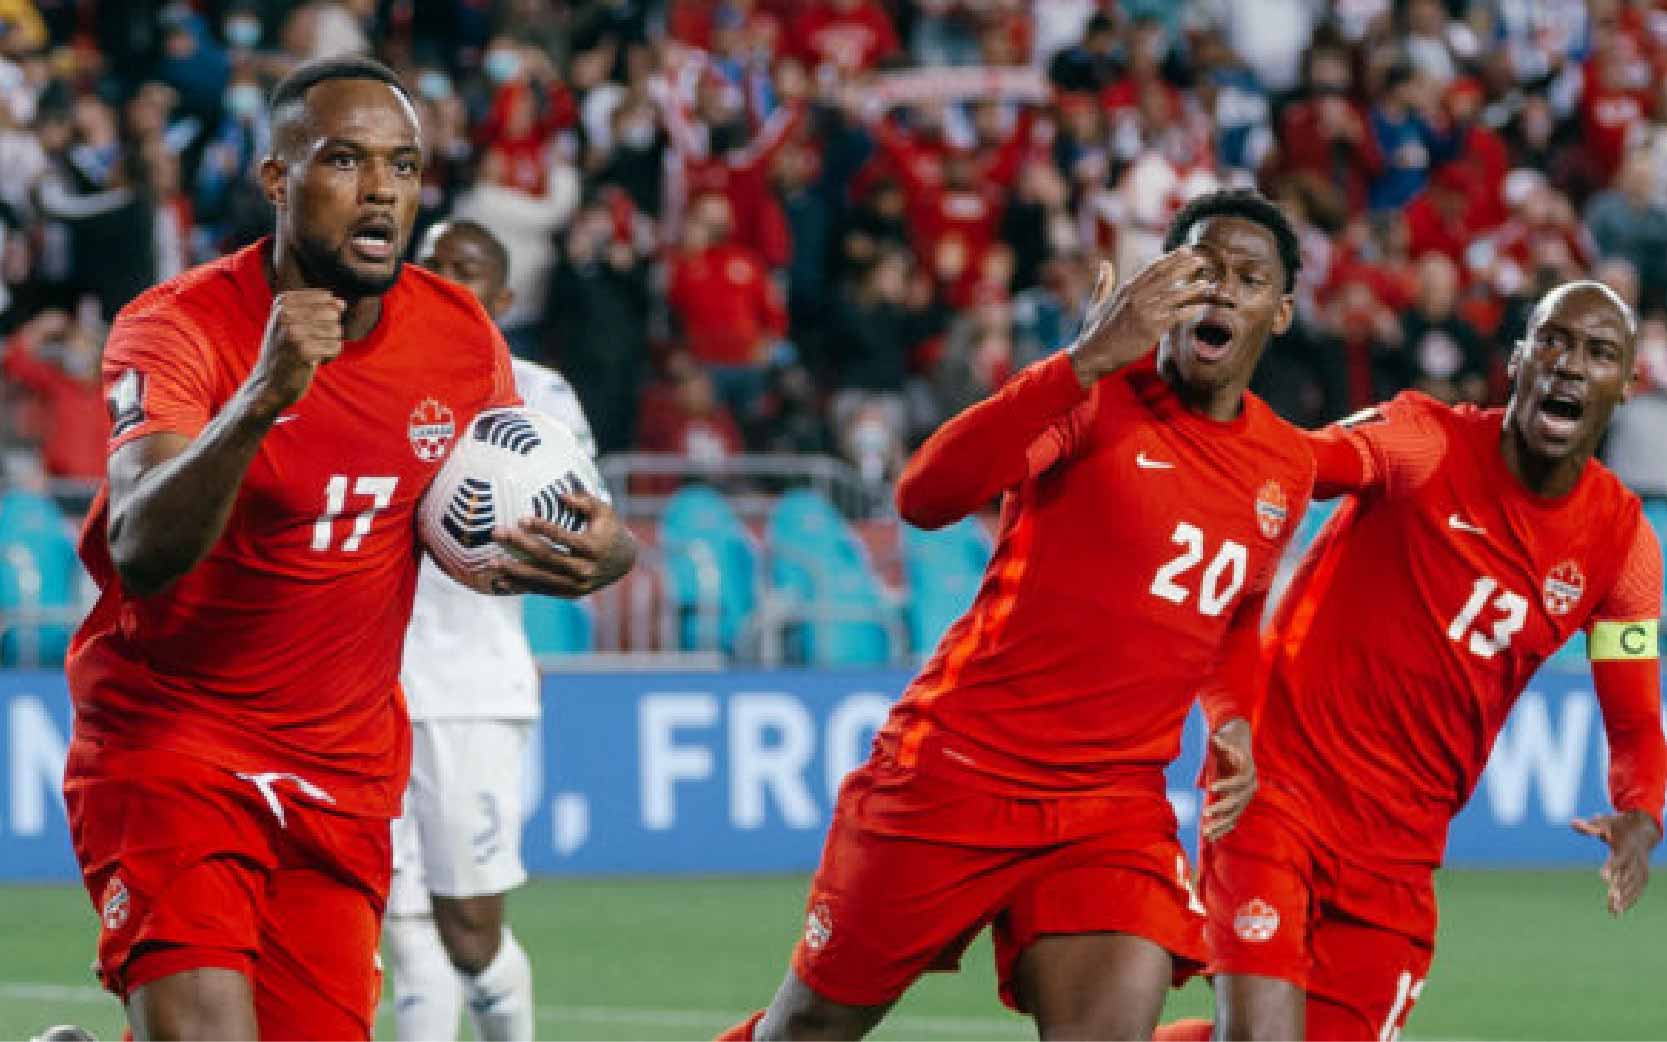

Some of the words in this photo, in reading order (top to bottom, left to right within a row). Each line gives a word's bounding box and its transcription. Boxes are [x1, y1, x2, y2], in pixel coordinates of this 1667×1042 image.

[312, 475, 399, 552] 17
[1150, 521, 1248, 617] 20
[1449, 575, 1528, 660] 13
[1620, 625, 1646, 655] C
[1487, 691, 1612, 826] W
